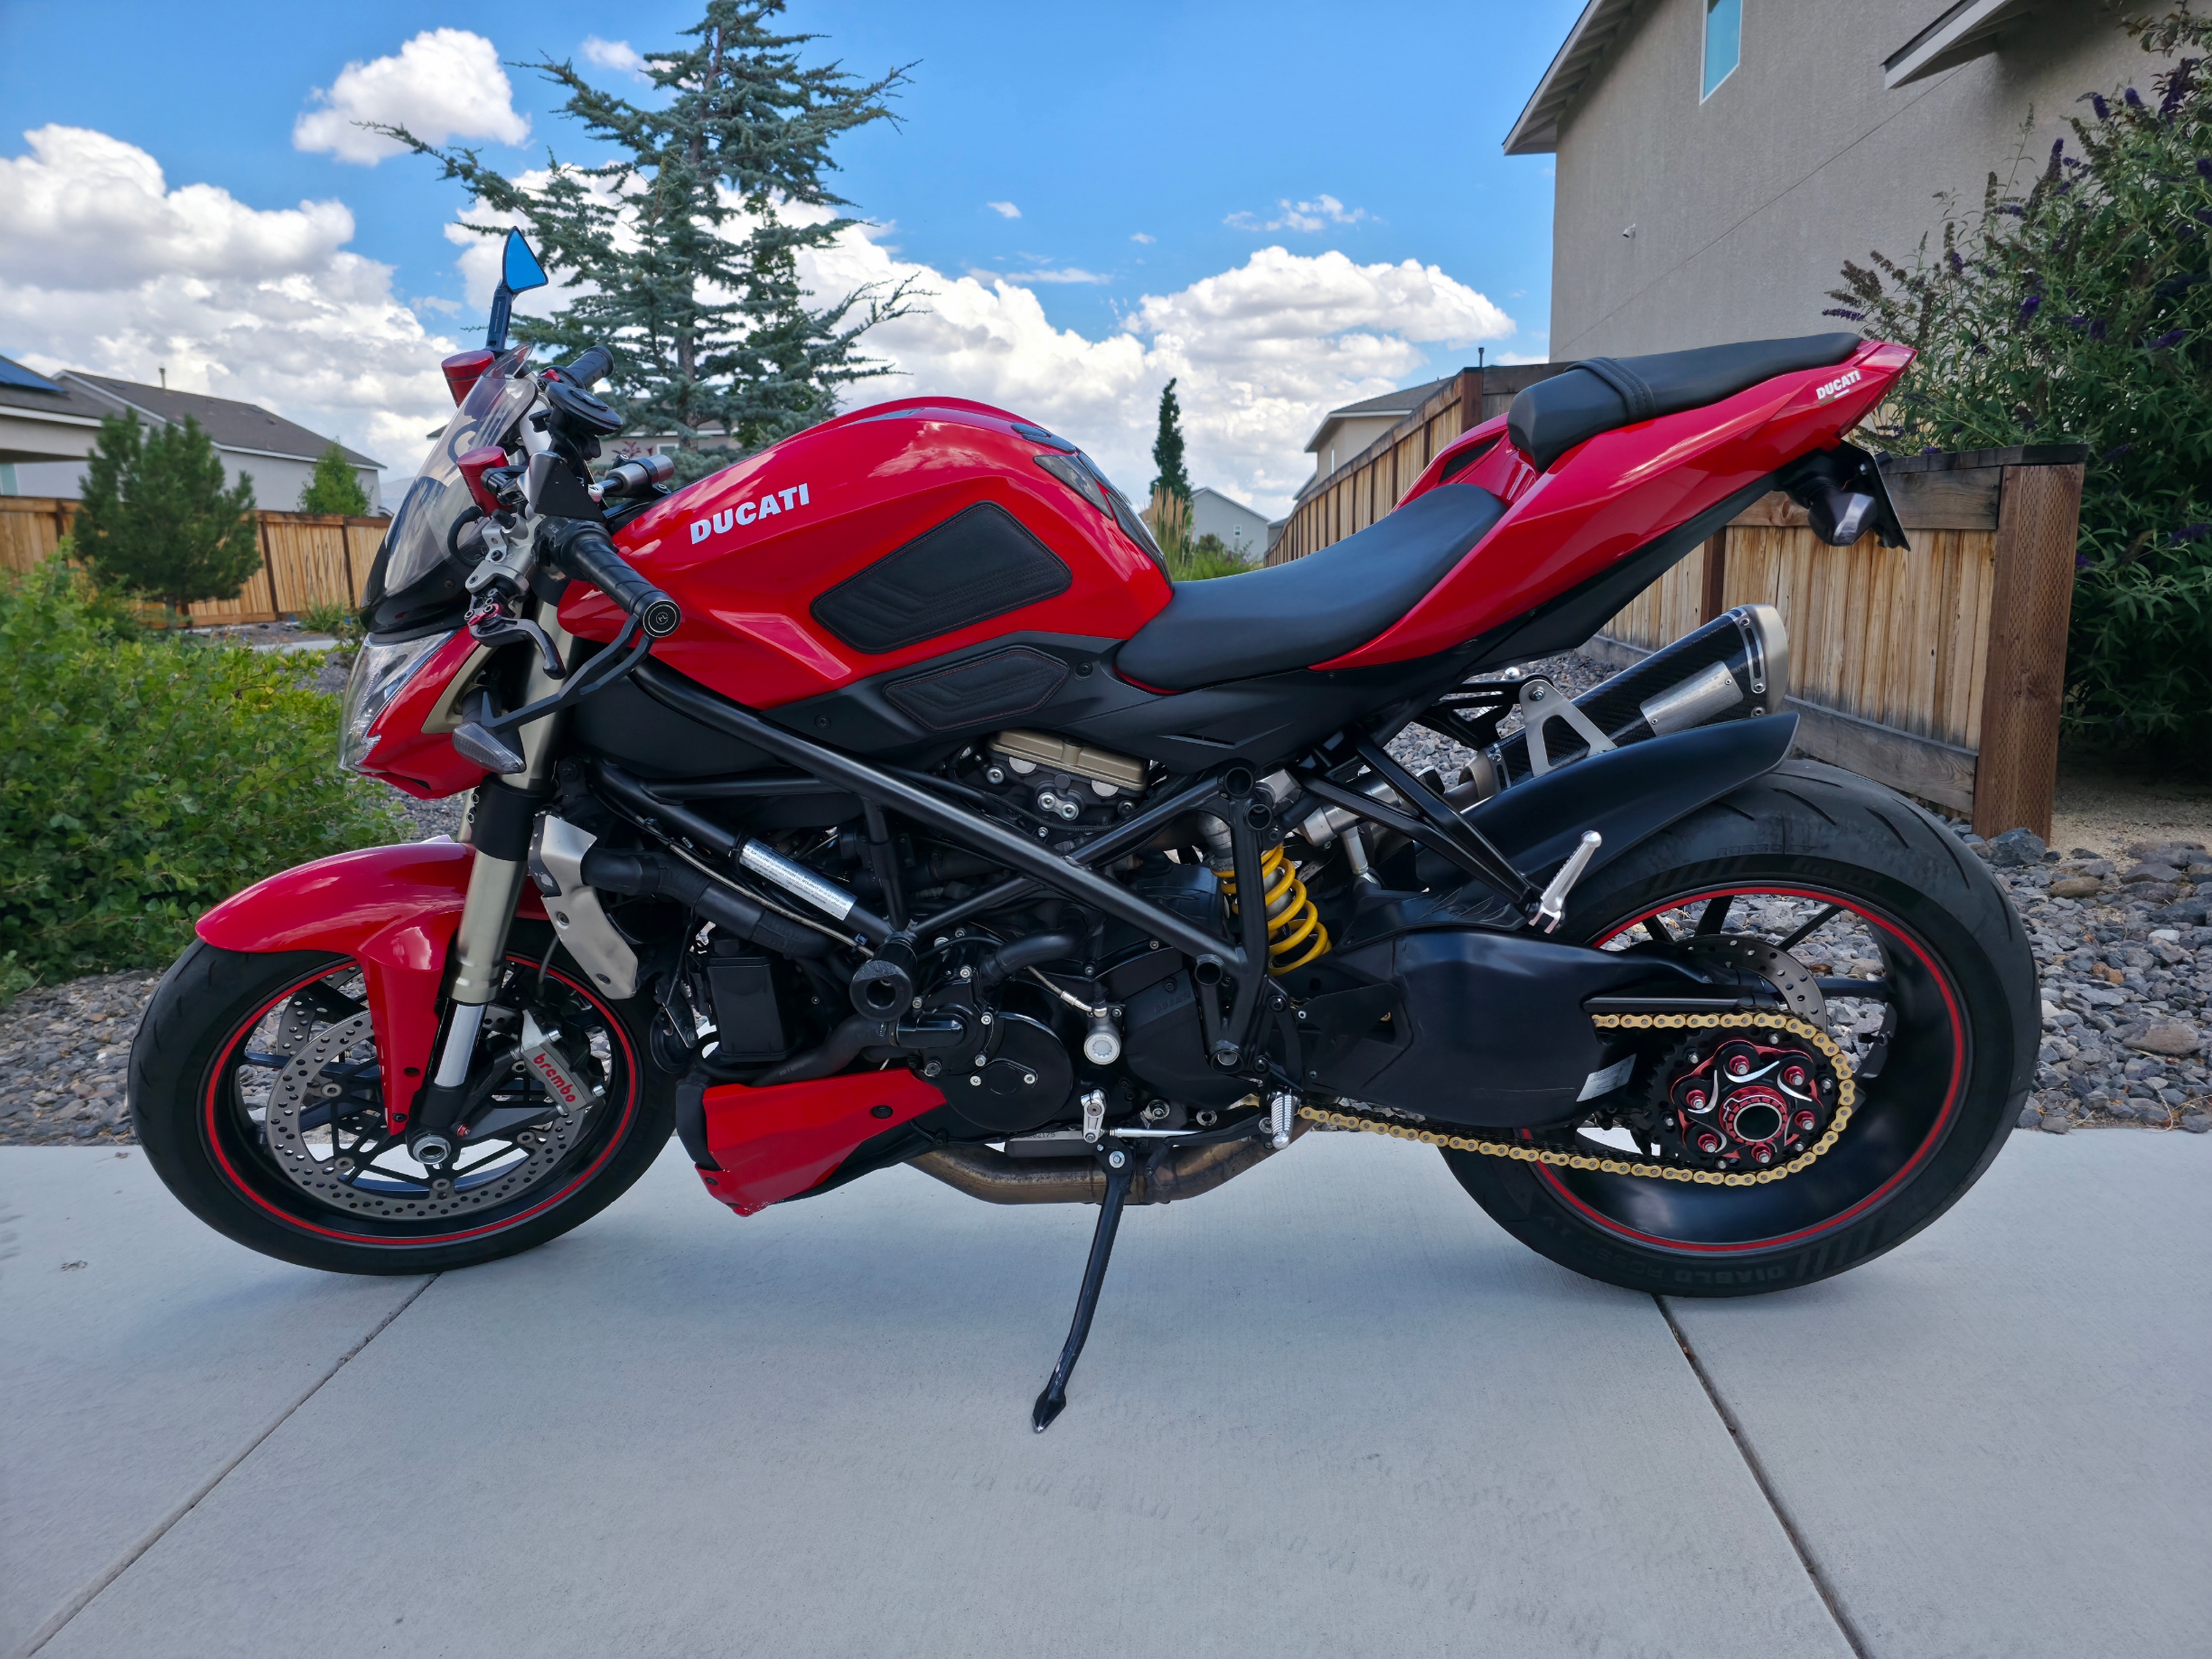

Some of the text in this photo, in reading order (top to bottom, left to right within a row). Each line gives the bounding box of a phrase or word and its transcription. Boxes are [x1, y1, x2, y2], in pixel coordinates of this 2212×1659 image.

[1816, 370, 1861, 400] DUCATI
[690, 482, 810, 544] DUCATI
[533, 1053, 576, 1103] brembo
[1673, 1265, 1786, 1285] DIABLO
